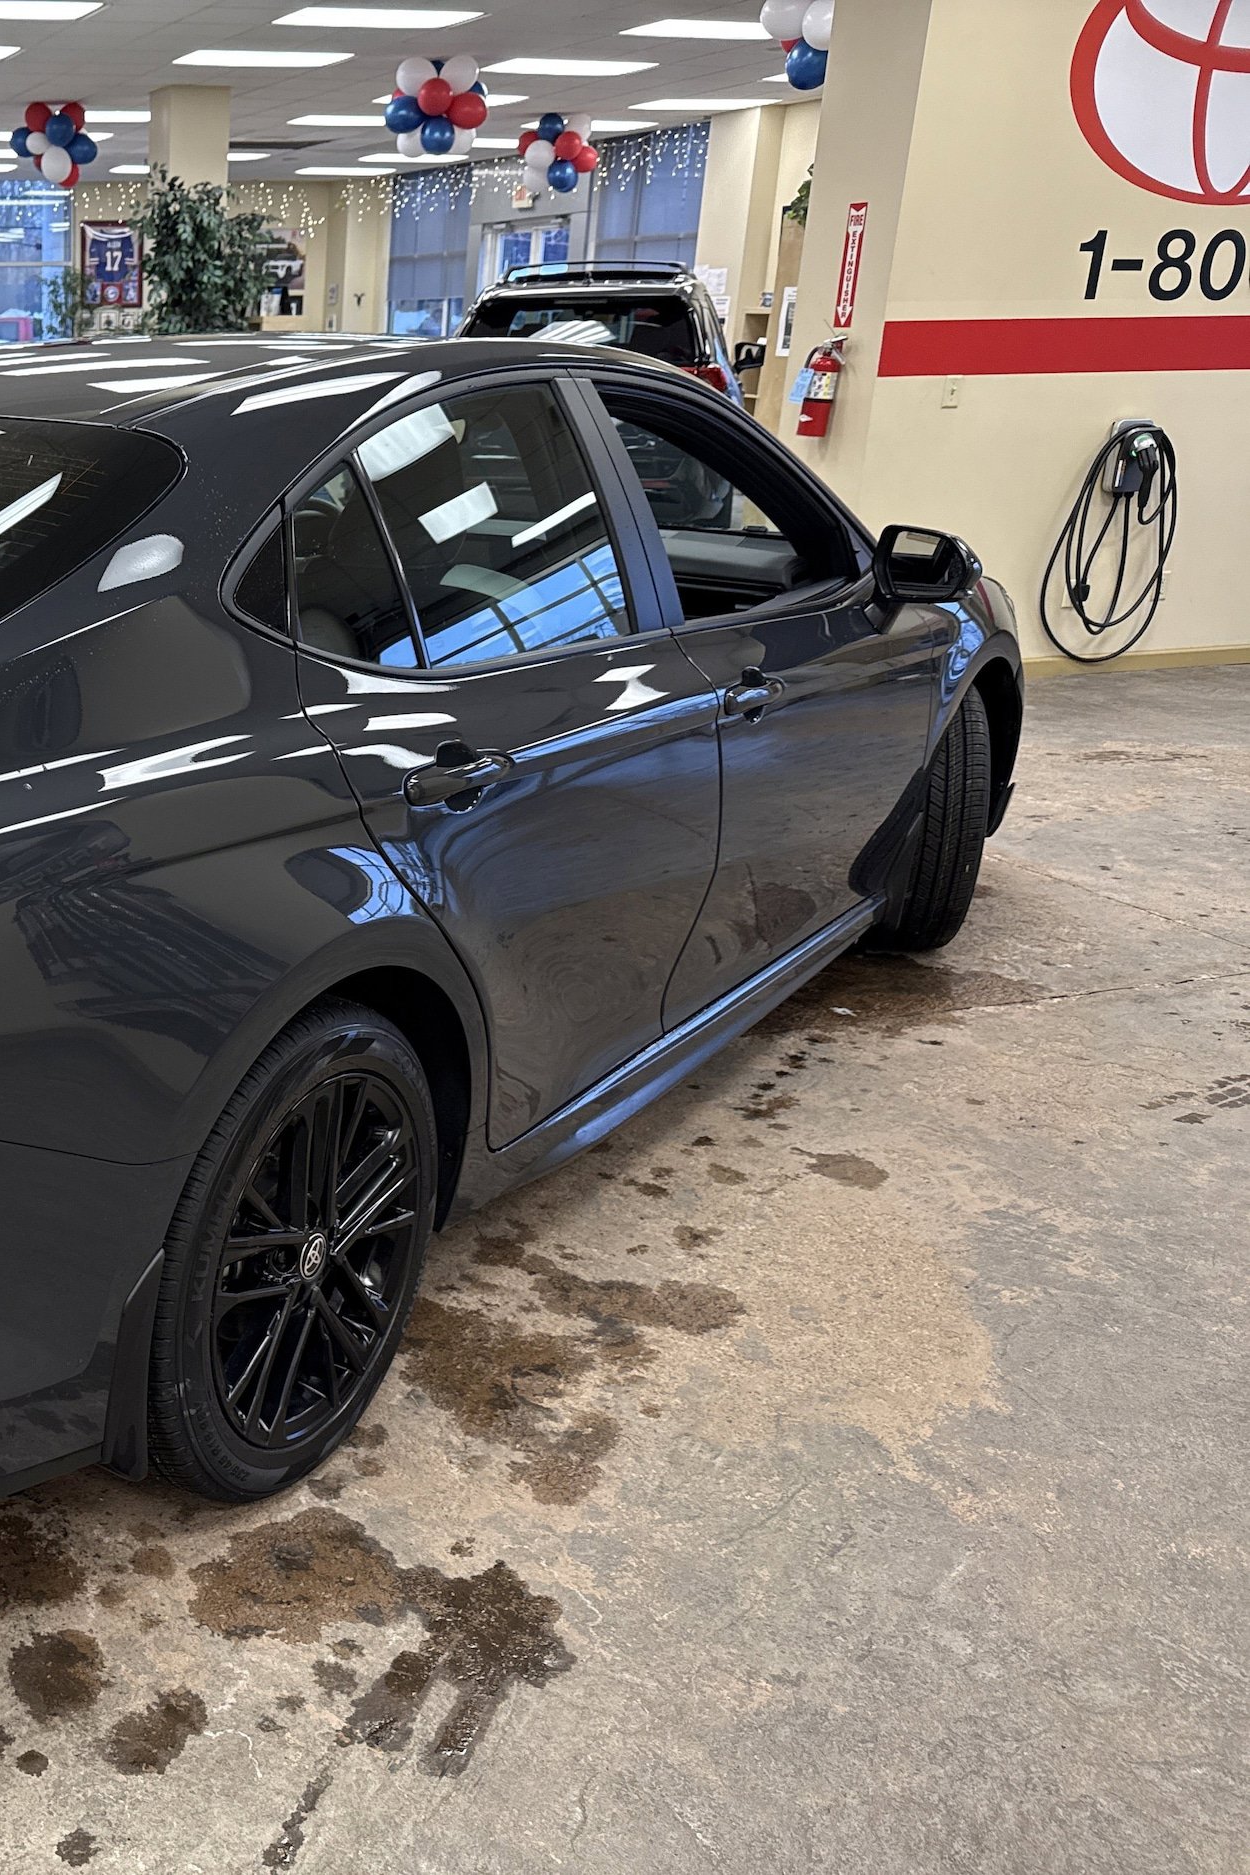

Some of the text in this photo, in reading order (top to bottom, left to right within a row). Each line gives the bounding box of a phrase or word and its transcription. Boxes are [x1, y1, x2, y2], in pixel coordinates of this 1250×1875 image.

[850, 214, 864, 226] FIRE
[105, 251, 123, 272] 17
[841, 231, 858, 318] EXTINGUISHER
[1079, 229, 1250, 300] 1-80
